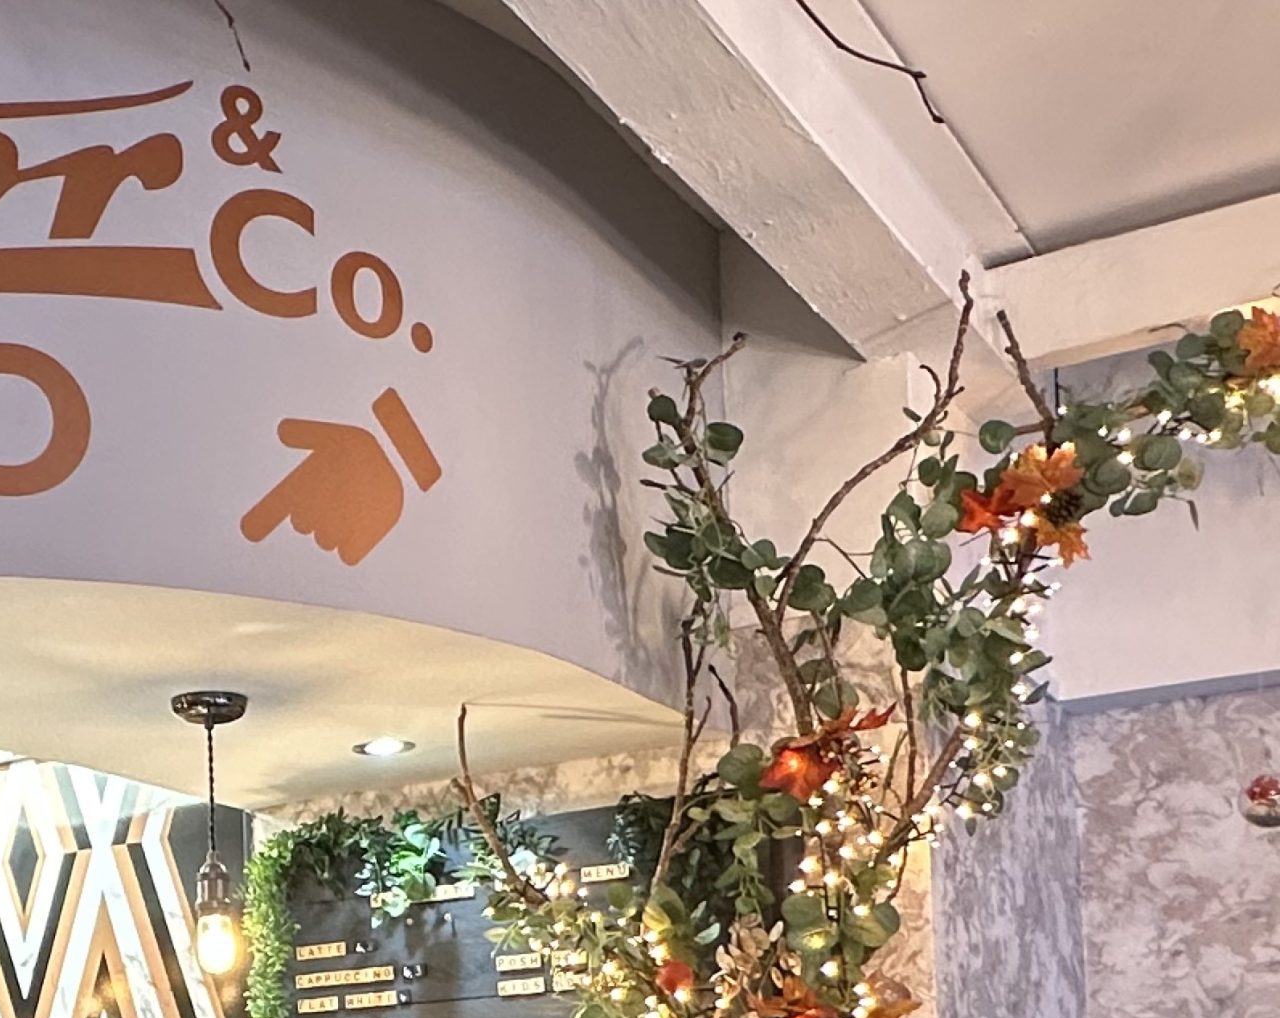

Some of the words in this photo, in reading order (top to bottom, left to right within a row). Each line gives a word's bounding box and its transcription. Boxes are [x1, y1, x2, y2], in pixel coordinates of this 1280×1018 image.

[211, 85, 282, 173] &
[209, 189, 434, 353] Co.
[582, 863, 627, 879] MENU
[297, 943, 344, 958] LATTE
[498, 955, 539, 968] POSH
[297, 967, 392, 986] CAPPUCCINO
[499, 981, 541, 994] KIDS
